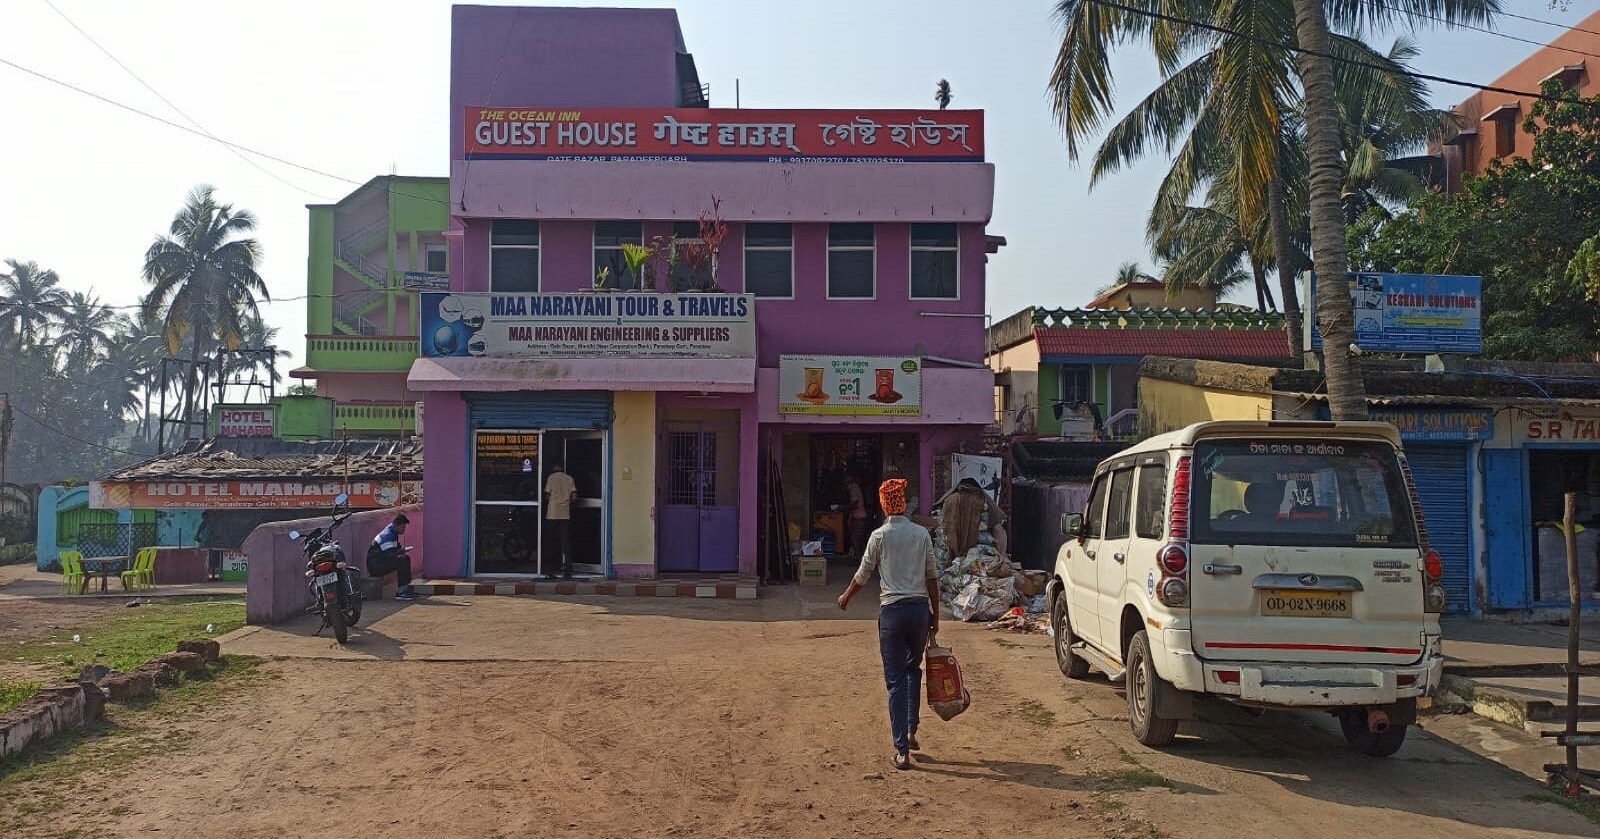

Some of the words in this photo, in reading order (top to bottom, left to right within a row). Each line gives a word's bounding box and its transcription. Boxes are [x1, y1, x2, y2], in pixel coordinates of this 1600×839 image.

[479, 111, 505, 120] THE
[509, 111, 554, 121] OCEAN
[557, 111, 581, 121] INN
[475, 121, 550, 145] GUEST
[557, 122, 637, 146] HOUSE
[491, 296, 527, 316] MAA
[530, 296, 612, 316] NARAYANI
[615, 297, 659, 316] TOUR
[662, 299, 675, 316] &
[678, 297, 748, 317] TRAVELS
[1428, 294, 1477, 309] SOLUTIONS
[508, 327, 532, 341] MAA
[535, 327, 588, 341] NARAYANI
[590, 327, 659, 341] ENGINEERING
[662, 329, 670, 341] &
[672, 327, 730, 341] SUPPLIERS
[221, 411, 271, 422] HOTEL
[1527, 421, 1563, 439] S.R
[1571, 419, 1600, 439] TA
[147, 483, 233, 496] HOTEL
